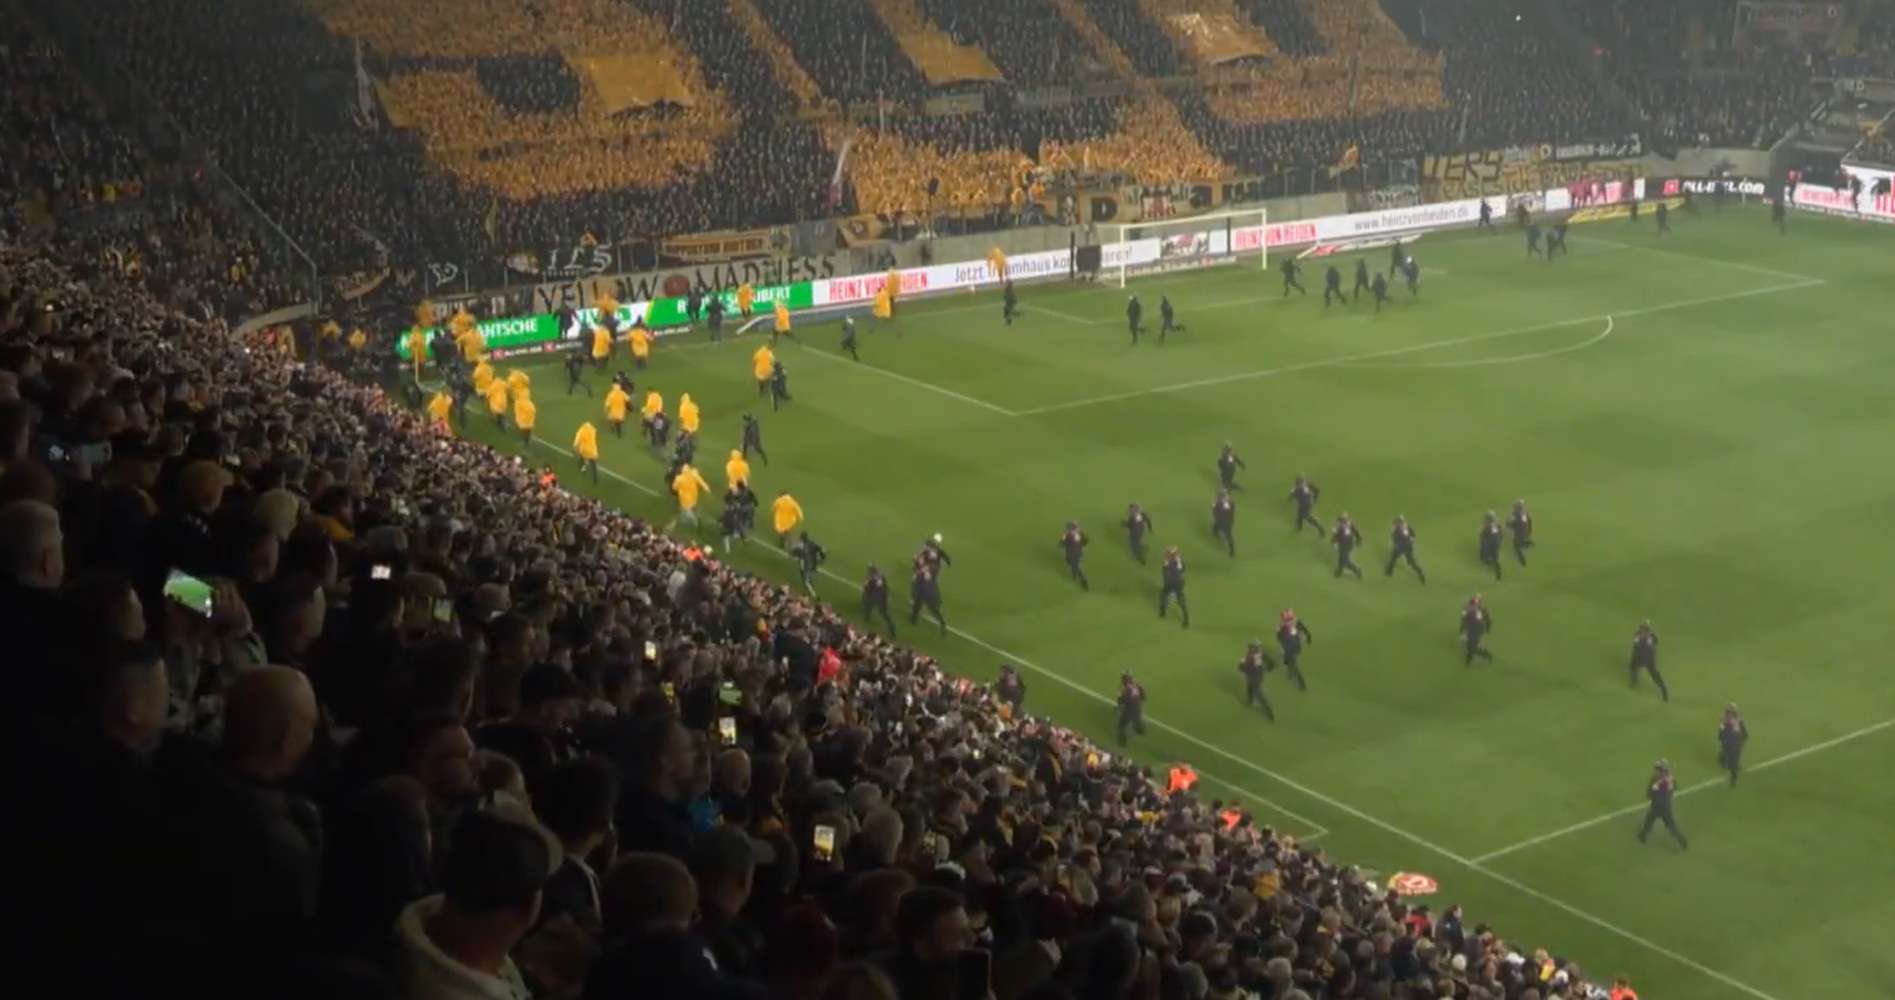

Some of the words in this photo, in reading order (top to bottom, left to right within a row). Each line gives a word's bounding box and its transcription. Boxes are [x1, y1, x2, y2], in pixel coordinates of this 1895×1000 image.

[696, 255, 833, 292] MADNESS
[955, 265, 983, 284] Jetzt
[829, 280, 862, 302] HEINZ
